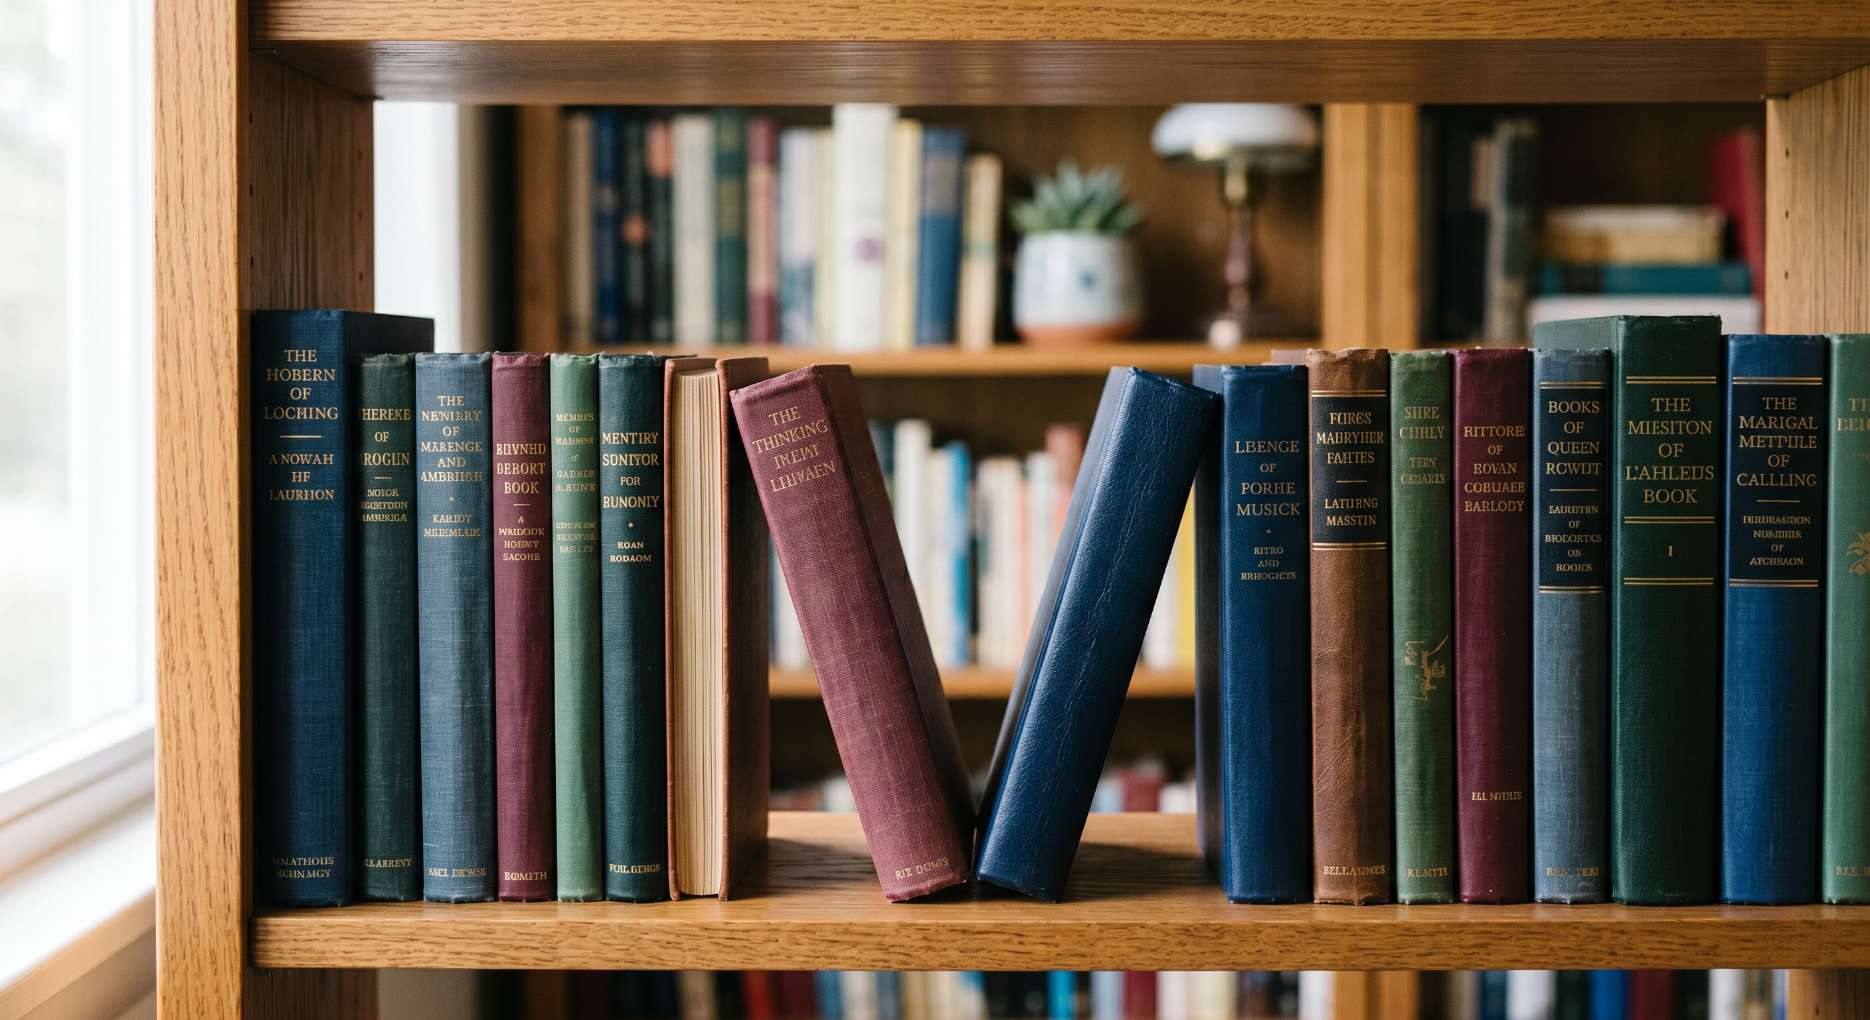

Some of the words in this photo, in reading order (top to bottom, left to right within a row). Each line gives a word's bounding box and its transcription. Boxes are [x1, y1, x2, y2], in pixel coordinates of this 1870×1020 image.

[284, 350, 317, 362] THE
[266, 368, 335, 381] HOBERN
[290, 387, 311, 400] OF
[438, 395, 465, 406] THE
[1548, 400, 1600, 414] BOOKS
[1651, 397, 1691, 412] THE
[1762, 397, 1797, 410] THE
[768, 406, 801, 426] THE
[1738, 416, 1818, 429] MARIGAL
[442, 426, 460, 437] OF
[1564, 421, 1585, 434] OF
[375, 431, 389, 442] OF
[752, 419, 828, 454] THINKING
[1488, 445, 1503, 455] OF
[1547, 441, 1600, 456] QUEEN
[1658, 443, 1684, 458] OF
[438, 457, 466, 468] AND
[1767, 454, 1790, 467] OF
[1260, 463, 1276, 473] OF
[620, 476, 641, 486] FOR
[504, 482, 539, 494] BOOK
[1643, 489, 1698, 504] BOOK
[1236, 503, 1301, 516] MUSICK
[1568, 520, 1581, 528] OF
[1770, 544, 1784, 552] OF
[1258, 560, 1279, 568] AND
